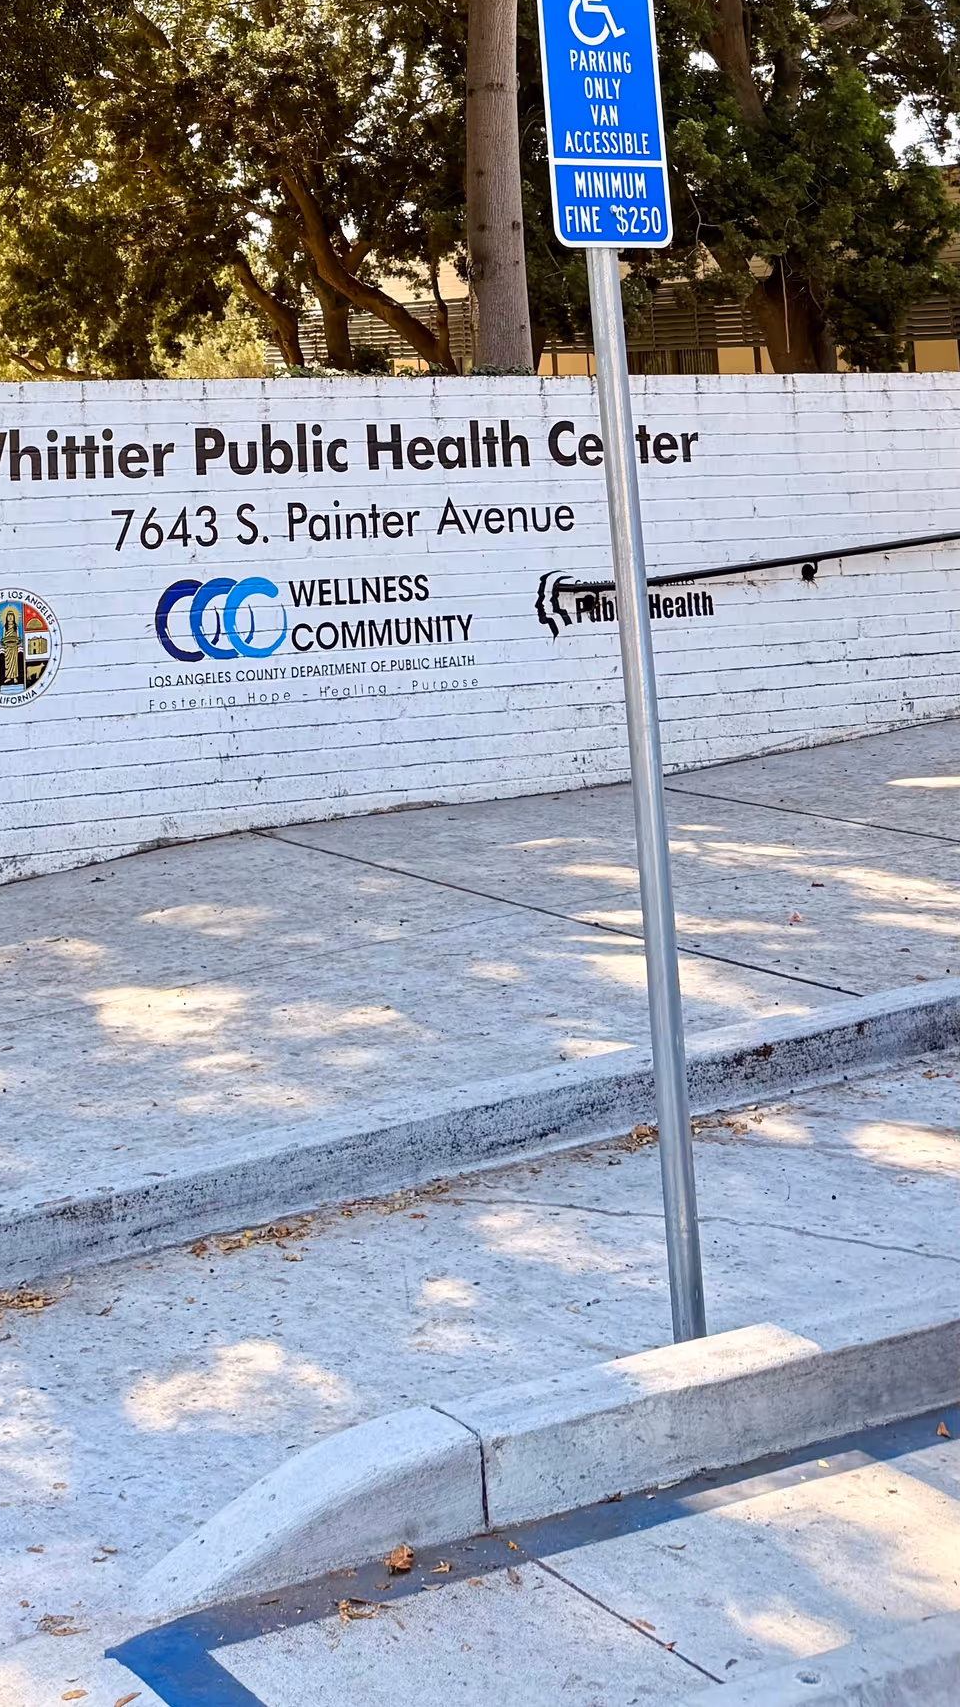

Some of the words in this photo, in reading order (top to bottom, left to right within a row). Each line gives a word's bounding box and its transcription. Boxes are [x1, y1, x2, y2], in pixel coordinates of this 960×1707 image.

[569, 50, 632, 74] PARKING
[583, 77, 621, 100] ONLY
[590, 105, 619, 127] VAN
[564, 131, 650, 155] ACCESSIBLE
[574, 171, 647, 199] MINIMUM
[565, 206, 602, 233] FINE
[616, 205, 661, 236] $250
[194, 423, 349, 476] Public
[366, 419, 530, 471] Health
[548, 420, 699, 467] Ceter
[111, 506, 219, 552] 7643
[236, 502, 269, 545] S.
[287, 499, 420, 542] Painter
[437, 496, 575, 536] Avenue
[288, 574, 430, 608] WELLNESS
[648, 591, 714, 620] Health
[7, 591, 24, 600] LOS
[24, 595, 56, 626] ANGELES
[291, 614, 473, 652] COMMUNITY
[148, 675, 172, 689] LOS
[175, 671, 232, 686] ANGELES
[235, 667, 287, 682] COUNTY
[291, 661, 367, 678] DEPARTMENT
[370, 660, 387, 673] OF
[390, 657, 430, 671] PUBLIC
[434, 655, 475, 669] HEALTH
[149, 695, 236, 711] Fostering
[247, 691, 291, 704] Hope
[319, 685, 387, 697] Healing
[412, 678, 479, 690] Purpose
